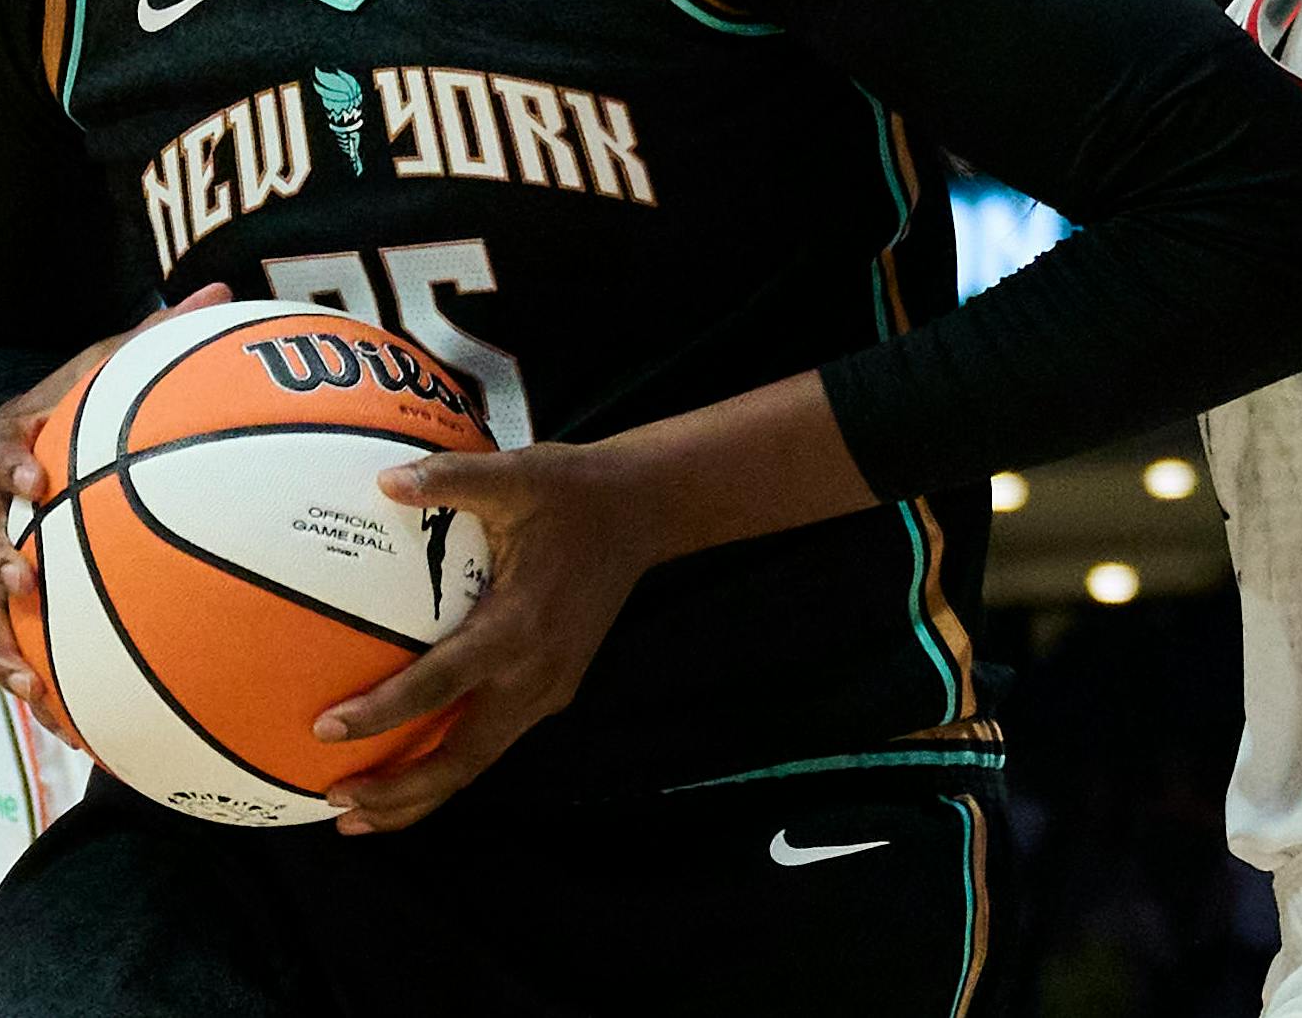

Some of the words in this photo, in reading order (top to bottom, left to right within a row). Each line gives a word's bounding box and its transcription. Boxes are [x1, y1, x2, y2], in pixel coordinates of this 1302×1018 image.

[141, 80, 311, 281] NEW
[372, 66, 658, 207] YORK
[292, 520, 348, 541] GAME
[353, 534, 398, 555] BALL
[308, 507, 390, 535] OFFICIAL
